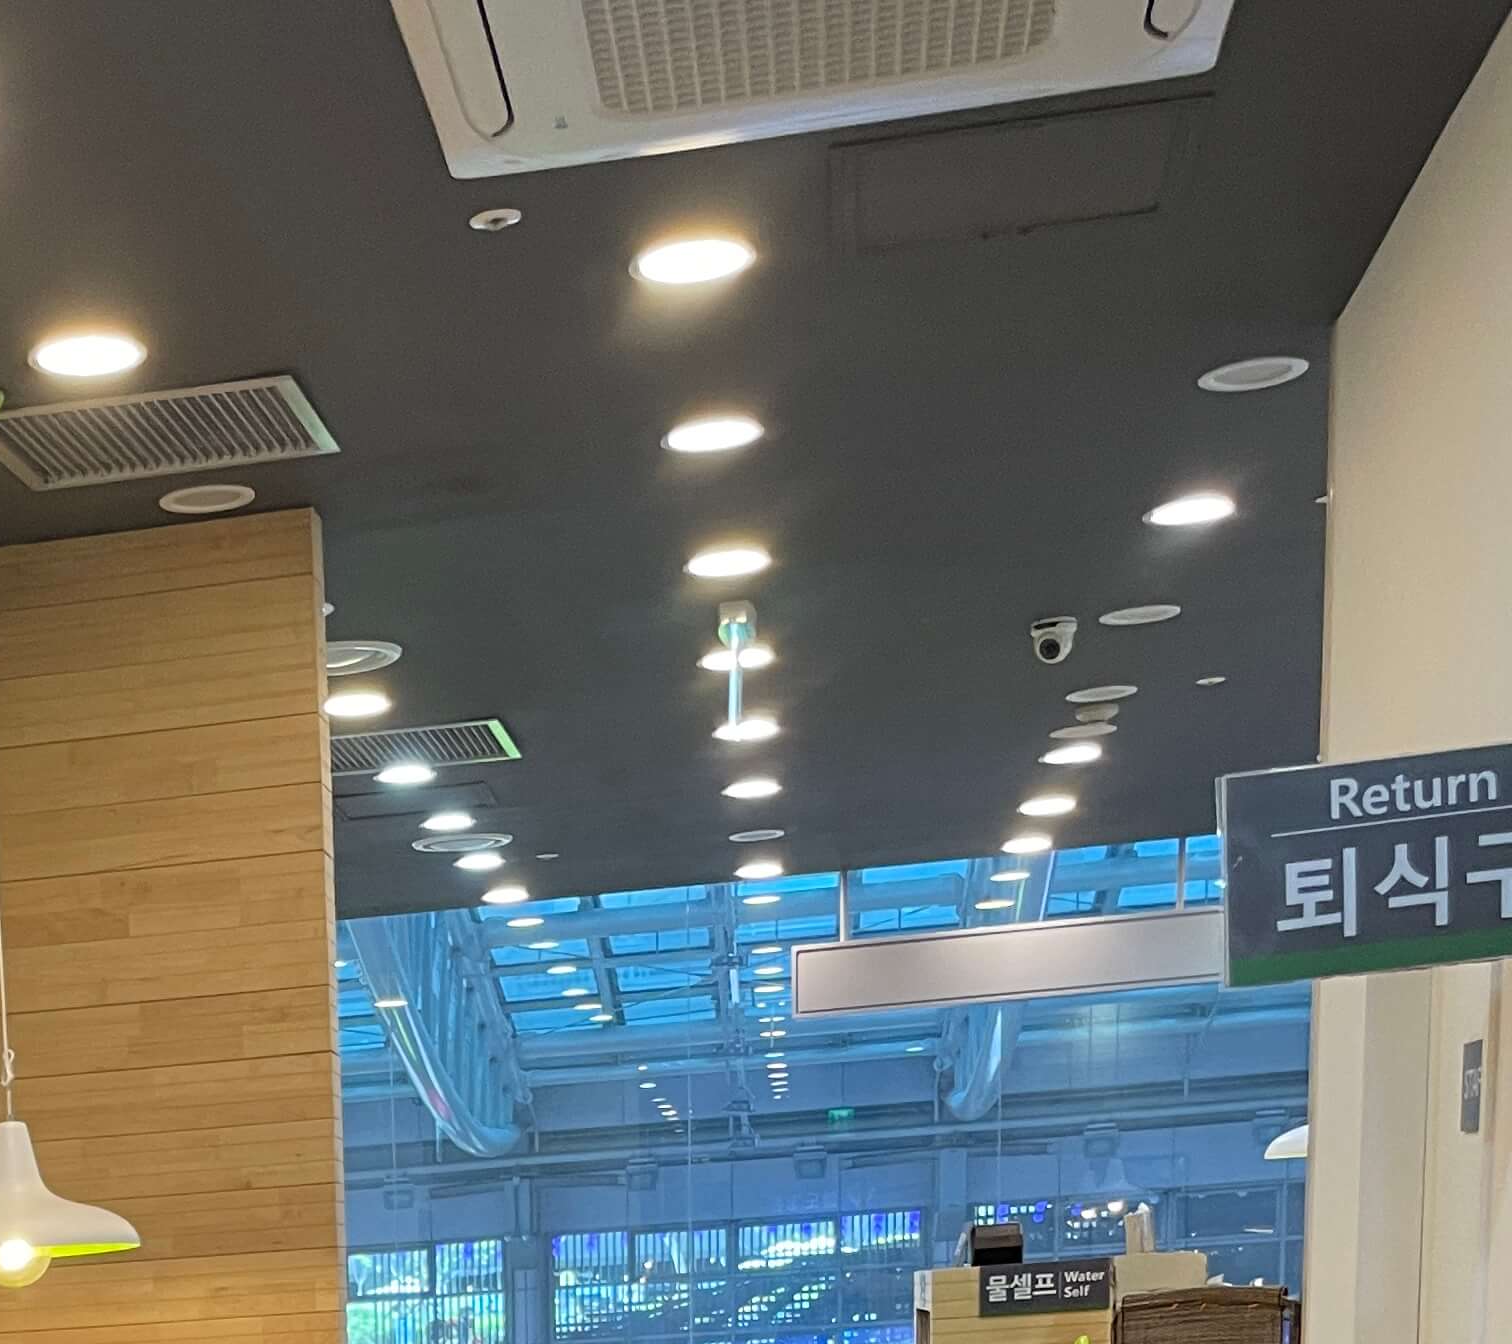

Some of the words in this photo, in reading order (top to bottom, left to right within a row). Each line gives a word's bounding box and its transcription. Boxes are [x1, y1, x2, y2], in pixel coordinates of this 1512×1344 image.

[1328, 769, 1498, 820] Return
[986, 1272, 1057, 1303] 물셀프
[1063, 1271, 1105, 1283] Water
[1063, 1285, 1090, 1298] Self
